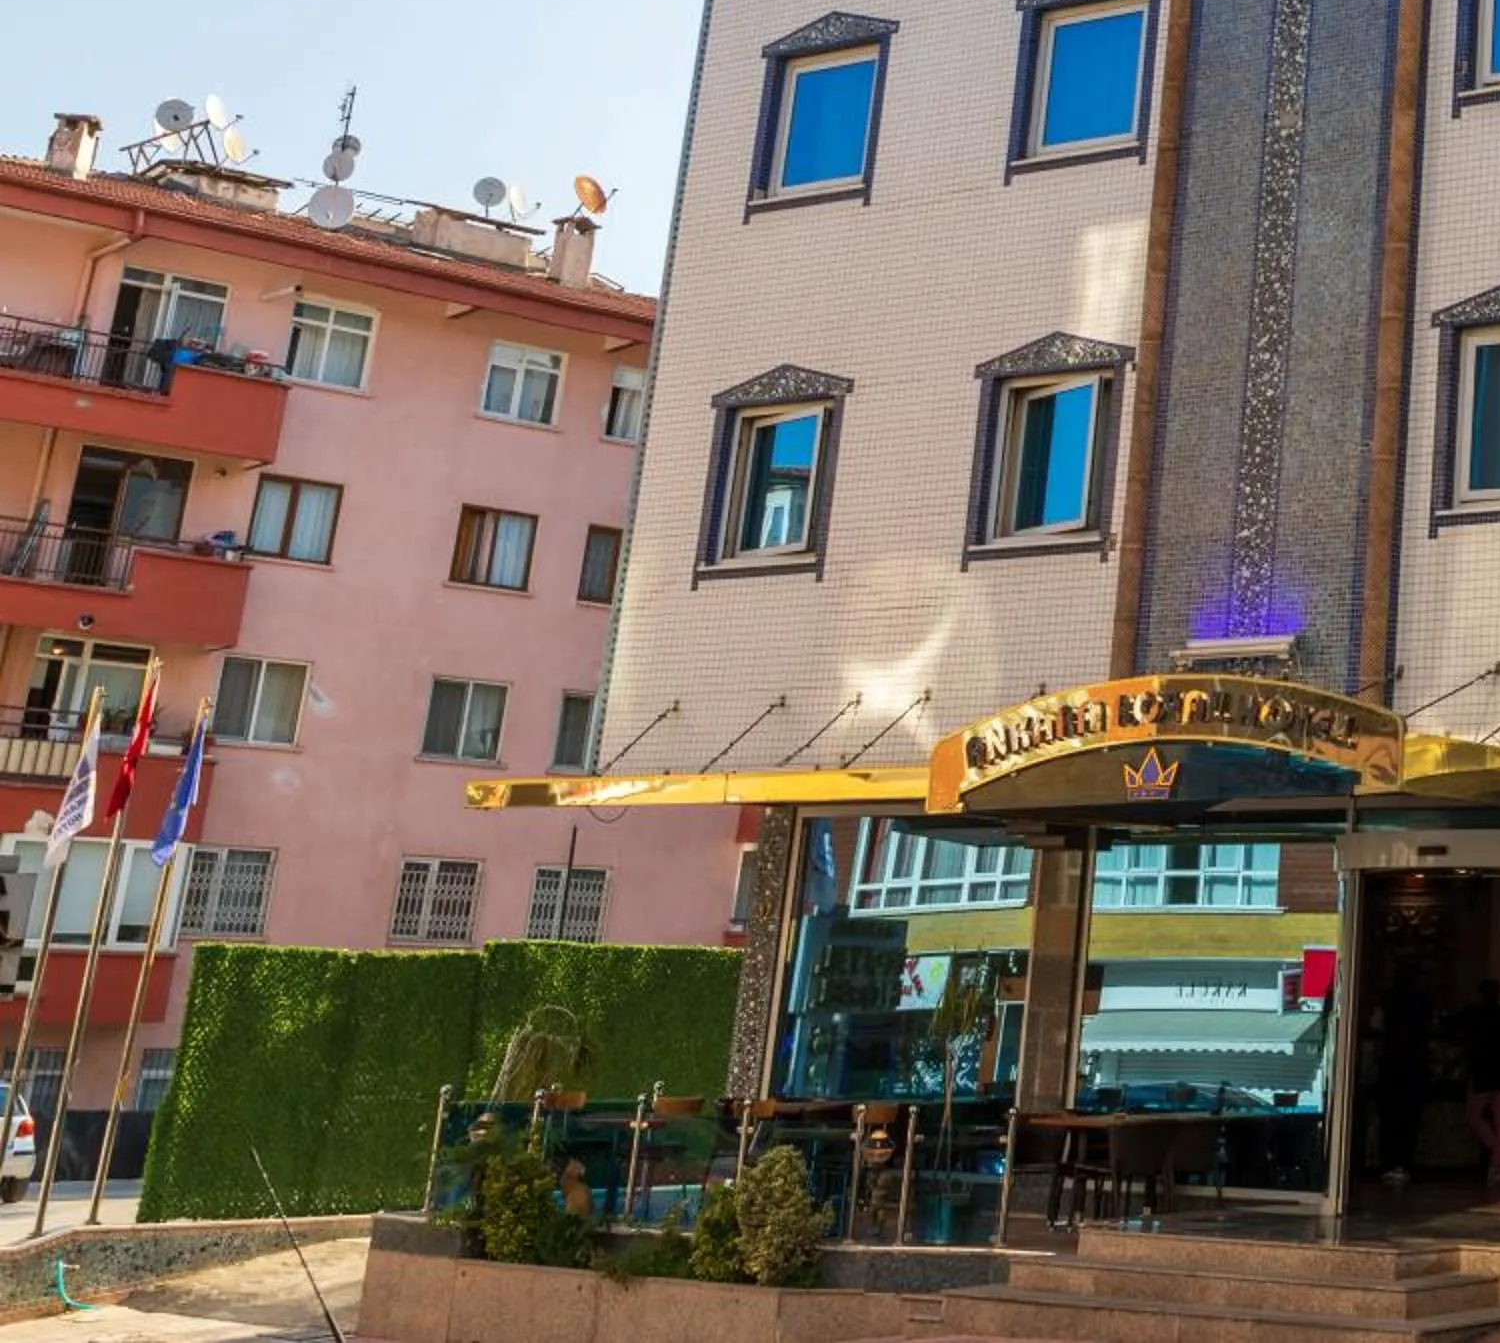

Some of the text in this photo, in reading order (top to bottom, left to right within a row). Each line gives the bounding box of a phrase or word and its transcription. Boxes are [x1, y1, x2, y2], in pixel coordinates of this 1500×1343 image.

[965, 690, 1359, 769] ANKARA ROYAL HOTEL
